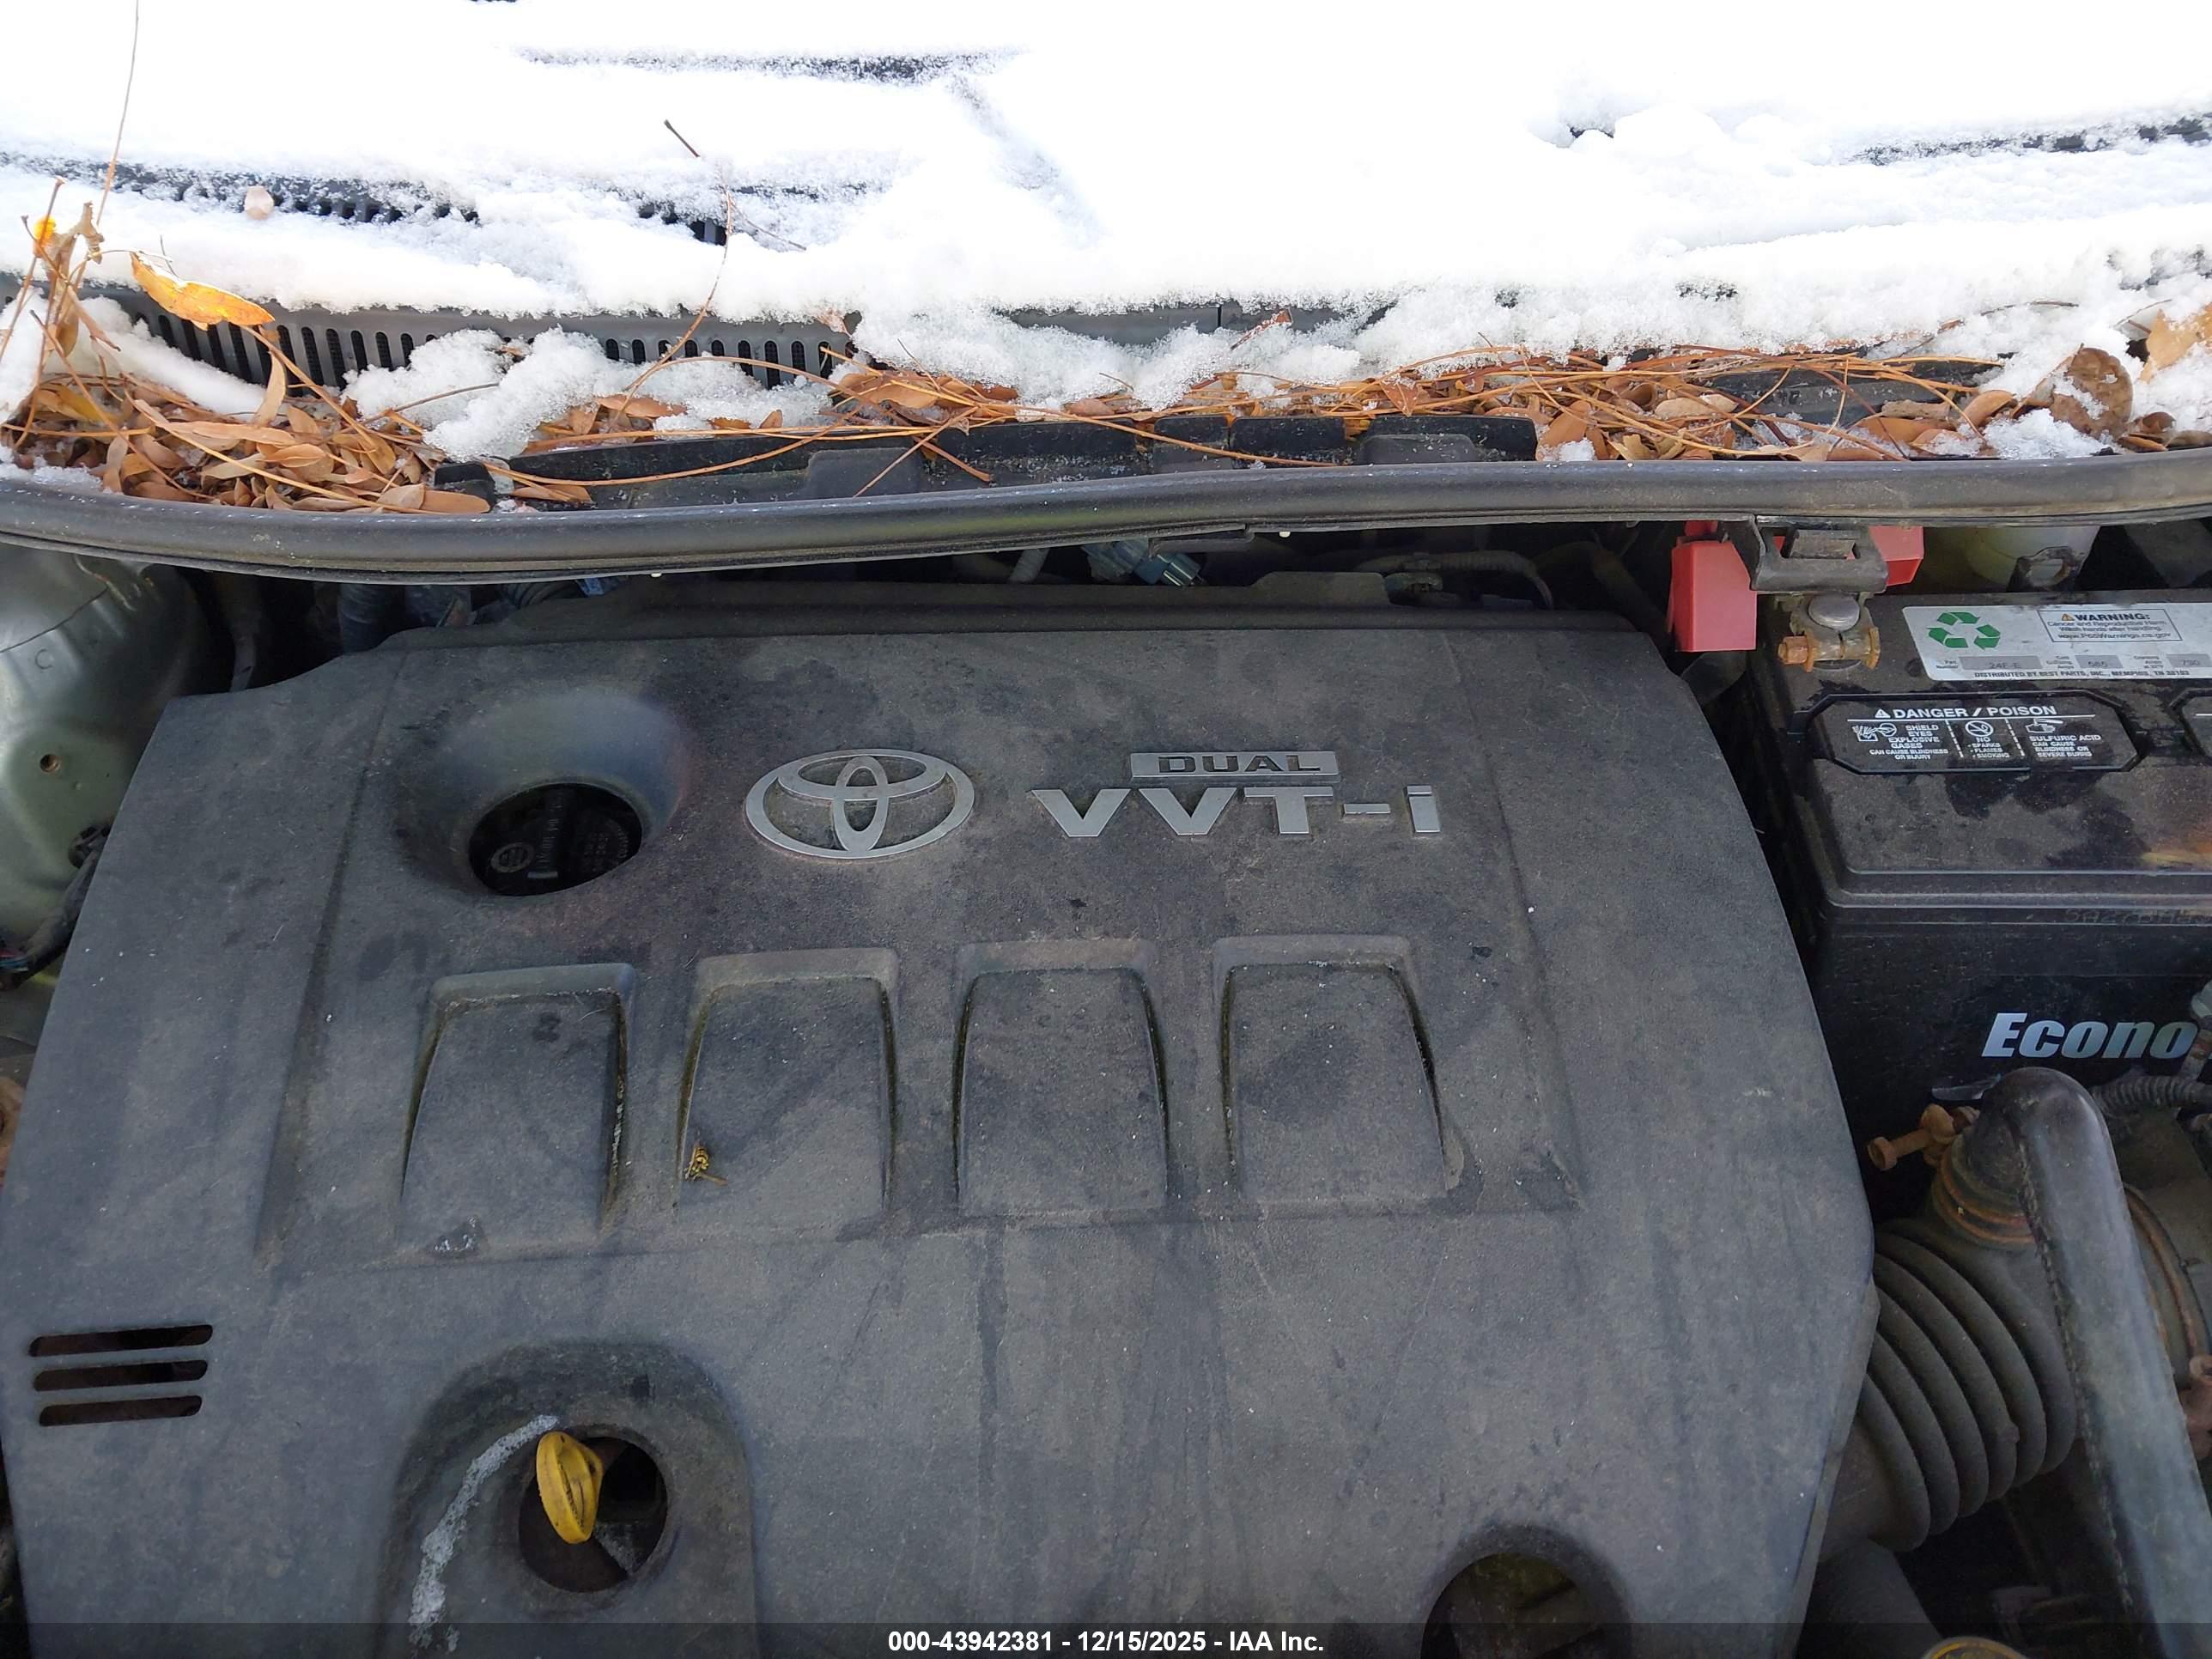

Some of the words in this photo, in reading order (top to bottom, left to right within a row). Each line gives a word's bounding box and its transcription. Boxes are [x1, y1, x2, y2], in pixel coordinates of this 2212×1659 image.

[2075, 612, 2150, 622] WARNING:
[1893, 708, 1969, 719] DANGER
[1987, 705, 2057, 717] POISON
[1159, 755, 1322, 773] DUAL
[1032, 785, 1441, 836] VVT-i
[1981, 1012, 2212, 1060] Econo
